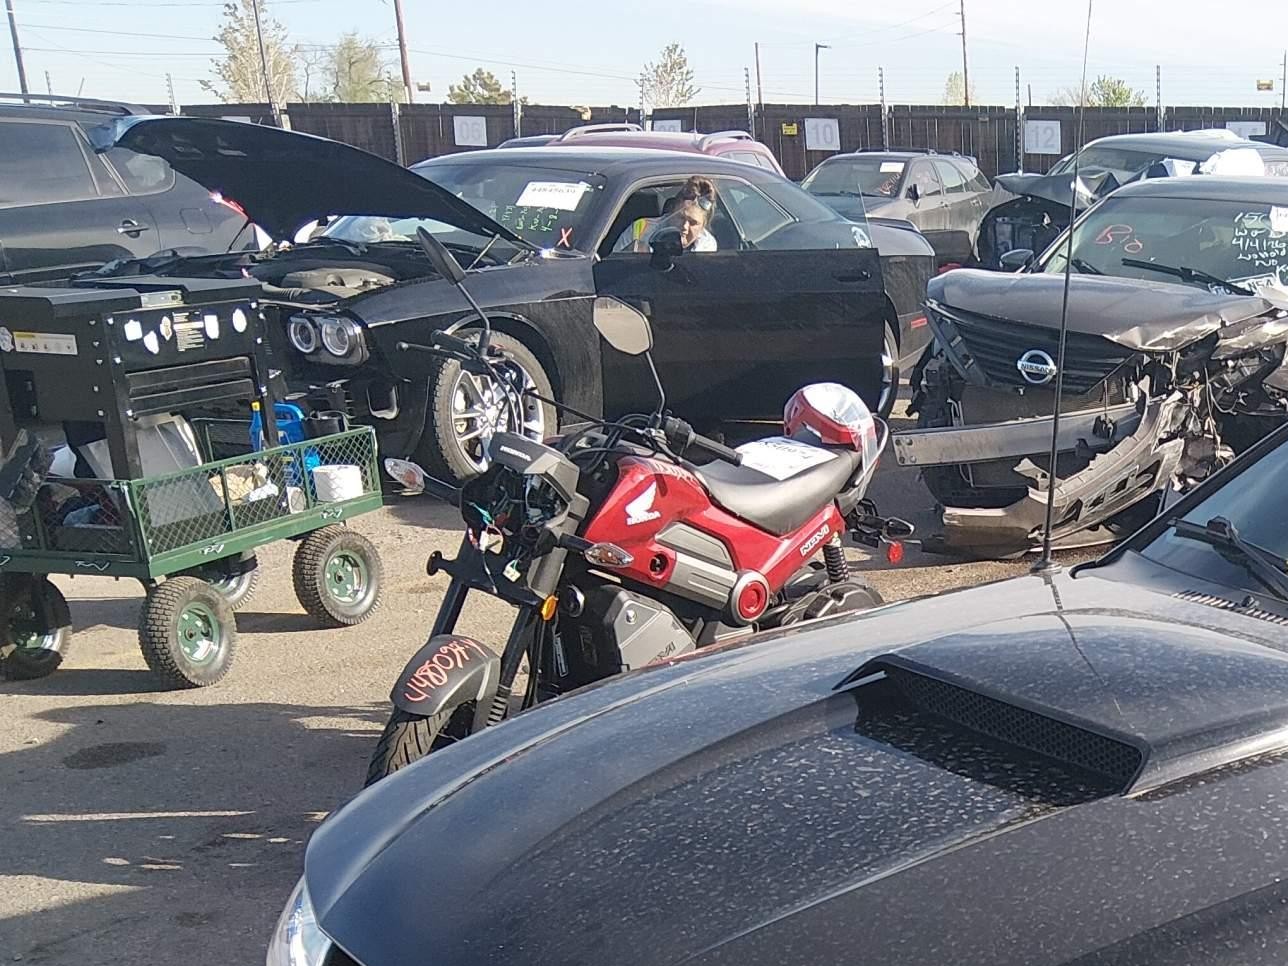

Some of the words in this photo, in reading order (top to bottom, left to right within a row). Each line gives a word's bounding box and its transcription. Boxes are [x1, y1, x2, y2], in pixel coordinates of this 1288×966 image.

[811, 123, 834, 145] 10
[1031, 125, 1056, 149] 12
[1019, 362, 1056, 377] NISSAN
[500, 445, 533, 463] HONDA
[626, 510, 662, 526] HONDA
